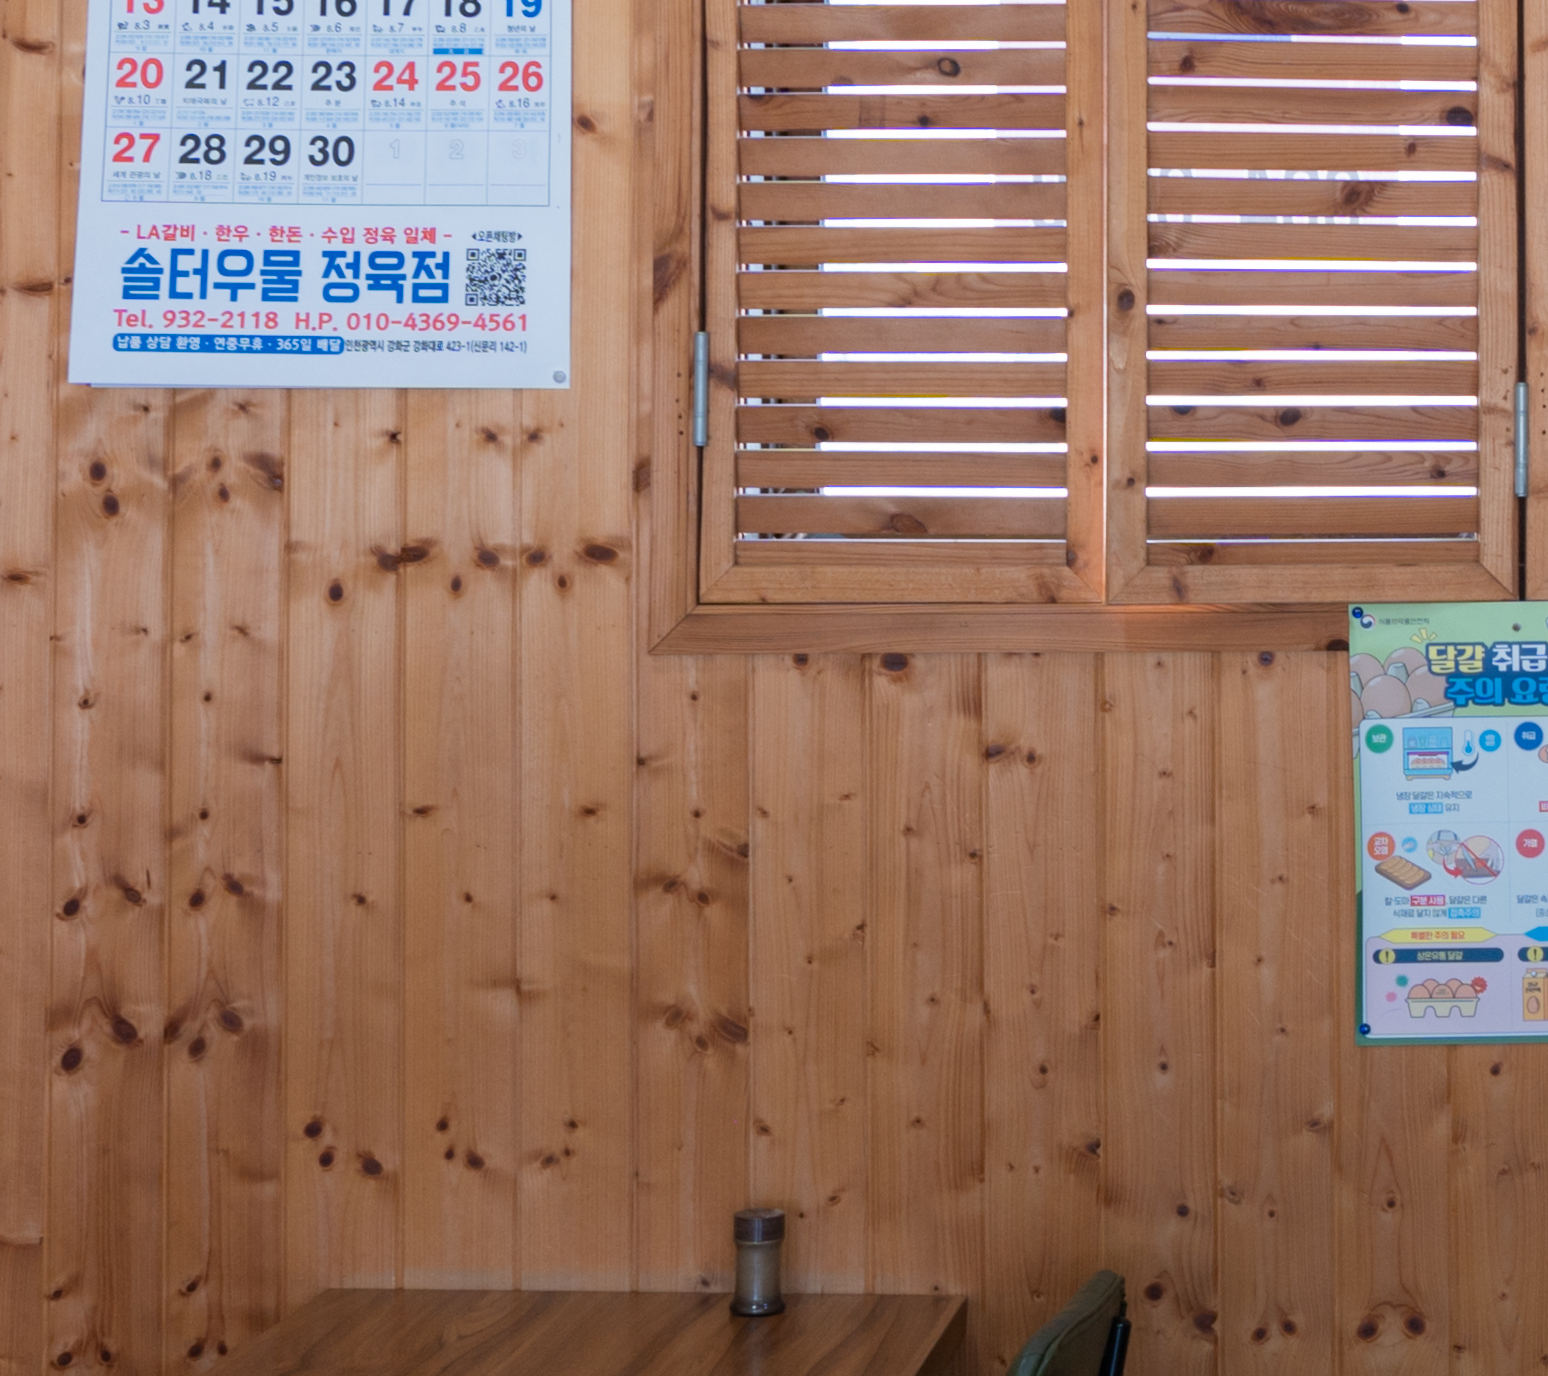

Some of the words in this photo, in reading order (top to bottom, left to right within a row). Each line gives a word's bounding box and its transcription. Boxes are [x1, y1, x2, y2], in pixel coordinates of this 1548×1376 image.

[115, 57, 164, 89] 20
[184, 58, 227, 90] 21
[246, 59, 294, 91] 22
[310, 60, 357, 92] 23
[372, 60, 419, 92] 24
[435, 60, 481, 92] 25
[498, 60, 544, 92] 26
[112, 132, 161, 163] 27
[178, 133, 227, 165] 28
[243, 135, 291, 166] 29
[308, 135, 355, 167] 30
[136, 224, 195, 242] LA갈비
[215, 225, 249, 243] 한우
[269, 226, 303, 243] 한돈
[321, 227, 355, 244] 수입
[362, 227, 396, 244] 정육
[403, 227, 436, 244] 일체
[121, 247, 303, 302] 솔터우물
[321, 250, 450, 304] 정육점
[113, 309, 153, 329] Tel.
[162, 310, 279, 330] 932-2118
[295, 312, 338, 332] H.P.
[347, 312, 527, 332] 010-4369-4561
[117, 335, 142, 350] 납품
[146, 335, 171, 350] 상담
[176, 335, 201, 351] 환영
[214, 336, 263, 352] 연중무휴
[276, 338, 312, 352] 365일
[317, 338, 342, 352] 배달
[1428, 645, 1486, 674] 달걀
[1492, 644, 1548, 672] 취급
[1446, 677, 1502, 705] 주의
